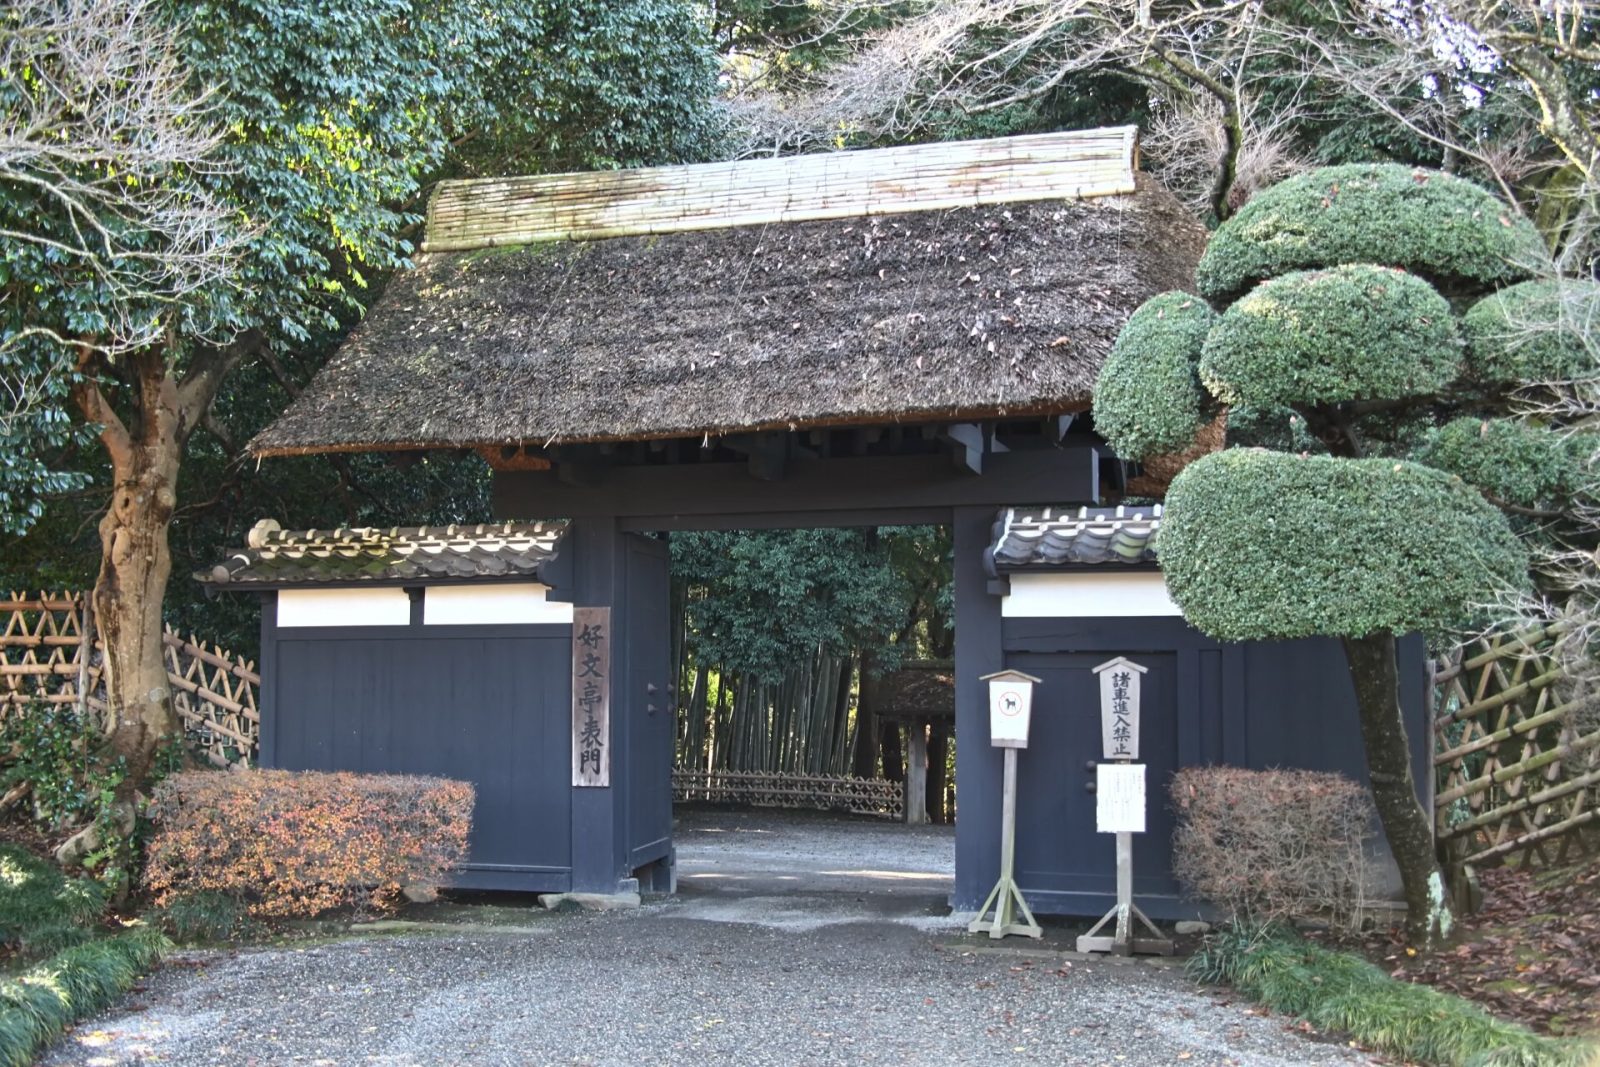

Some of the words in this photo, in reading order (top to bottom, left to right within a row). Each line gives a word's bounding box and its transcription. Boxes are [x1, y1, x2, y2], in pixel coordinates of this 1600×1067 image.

[577, 623, 604, 776] 好文亭表門
[1111, 671, 1131, 756] 諸車進入禁止
